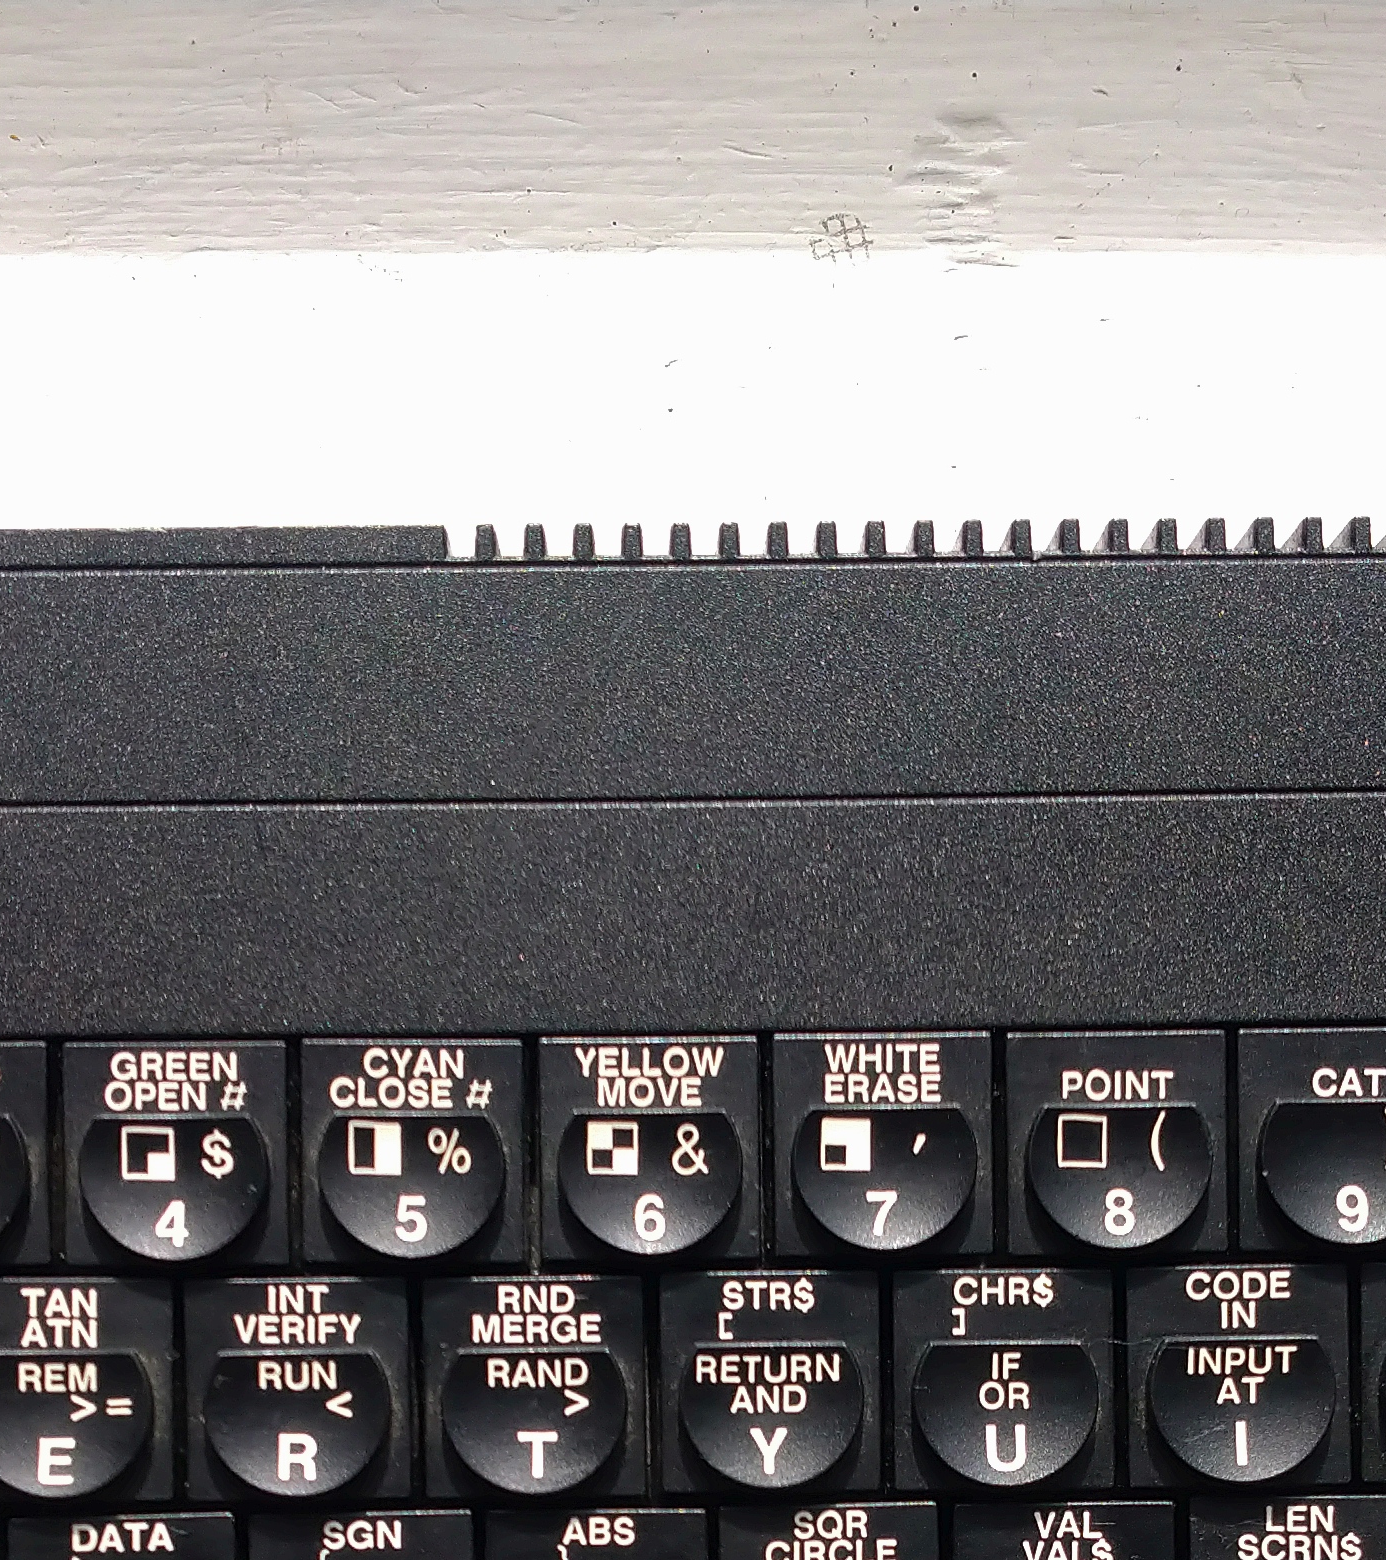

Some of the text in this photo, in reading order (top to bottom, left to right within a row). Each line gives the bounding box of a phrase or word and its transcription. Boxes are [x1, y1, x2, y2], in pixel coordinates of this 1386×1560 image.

[110, 1051, 238, 1082] GREEN
[363, 1047, 465, 1079] CYAN
[574, 1045, 725, 1076] YELLOW
[824, 1043, 941, 1074] WHITE
[104, 1080, 207, 1112] OPEN
[329, 1078, 454, 1109] CLOSE
[597, 1077, 703, 1108] MOVE
[824, 1074, 942, 1104] ERASE
[1061, 1068, 1174, 1102] POINT
[154, 1200, 190, 1248] 4
[394, 1194, 428, 1243] 5
[634, 1193, 666, 1241] 6
[866, 1190, 897, 1238] 7
[1104, 1188, 1137, 1236] 8
[1336, 1185, 1370, 1232] 9
[267, 1284, 330, 1315] INT
[497, 1284, 576, 1314] RND
[722, 1277, 815, 1314] STR$
[953, 1273, 1054, 1308] CHR$
[1185, 1270, 1291, 1301] CODE
[20, 1287, 98, 1318] TAN
[1220, 1300, 1256, 1330] IN
[20, 1319, 98, 1349] ATN
[233, 1313, 362, 1345] VERIFY
[471, 1313, 602, 1344] MERGE
[258, 1360, 337, 1391] RUN
[487, 1357, 589, 1388] RAND
[695, 1353, 840, 1384] RETURN
[991, 1351, 1022, 1380] IF
[1187, 1345, 1298, 1375] INPUT
[18, 1362, 98, 1393] REM
[1216, 1375, 1265, 1405] AT
[730, 1384, 807, 1414] AND
[978, 1381, 1030, 1411] OR
[37, 1437, 76, 1486] E
[277, 1433, 318, 1482] R
[517, 1431, 559, 1479] T
[749, 1427, 788, 1477] Y
[985, 1423, 1027, 1473] U
[562, 1515, 636, 1546] ABS
[793, 1509, 868, 1542] SQR
[1034, 1510, 1103, 1539] VAL
[1265, 1505, 1335, 1533] LEN
[71, 1521, 175, 1553] DATA
[323, 1519, 402, 1551] SGN
